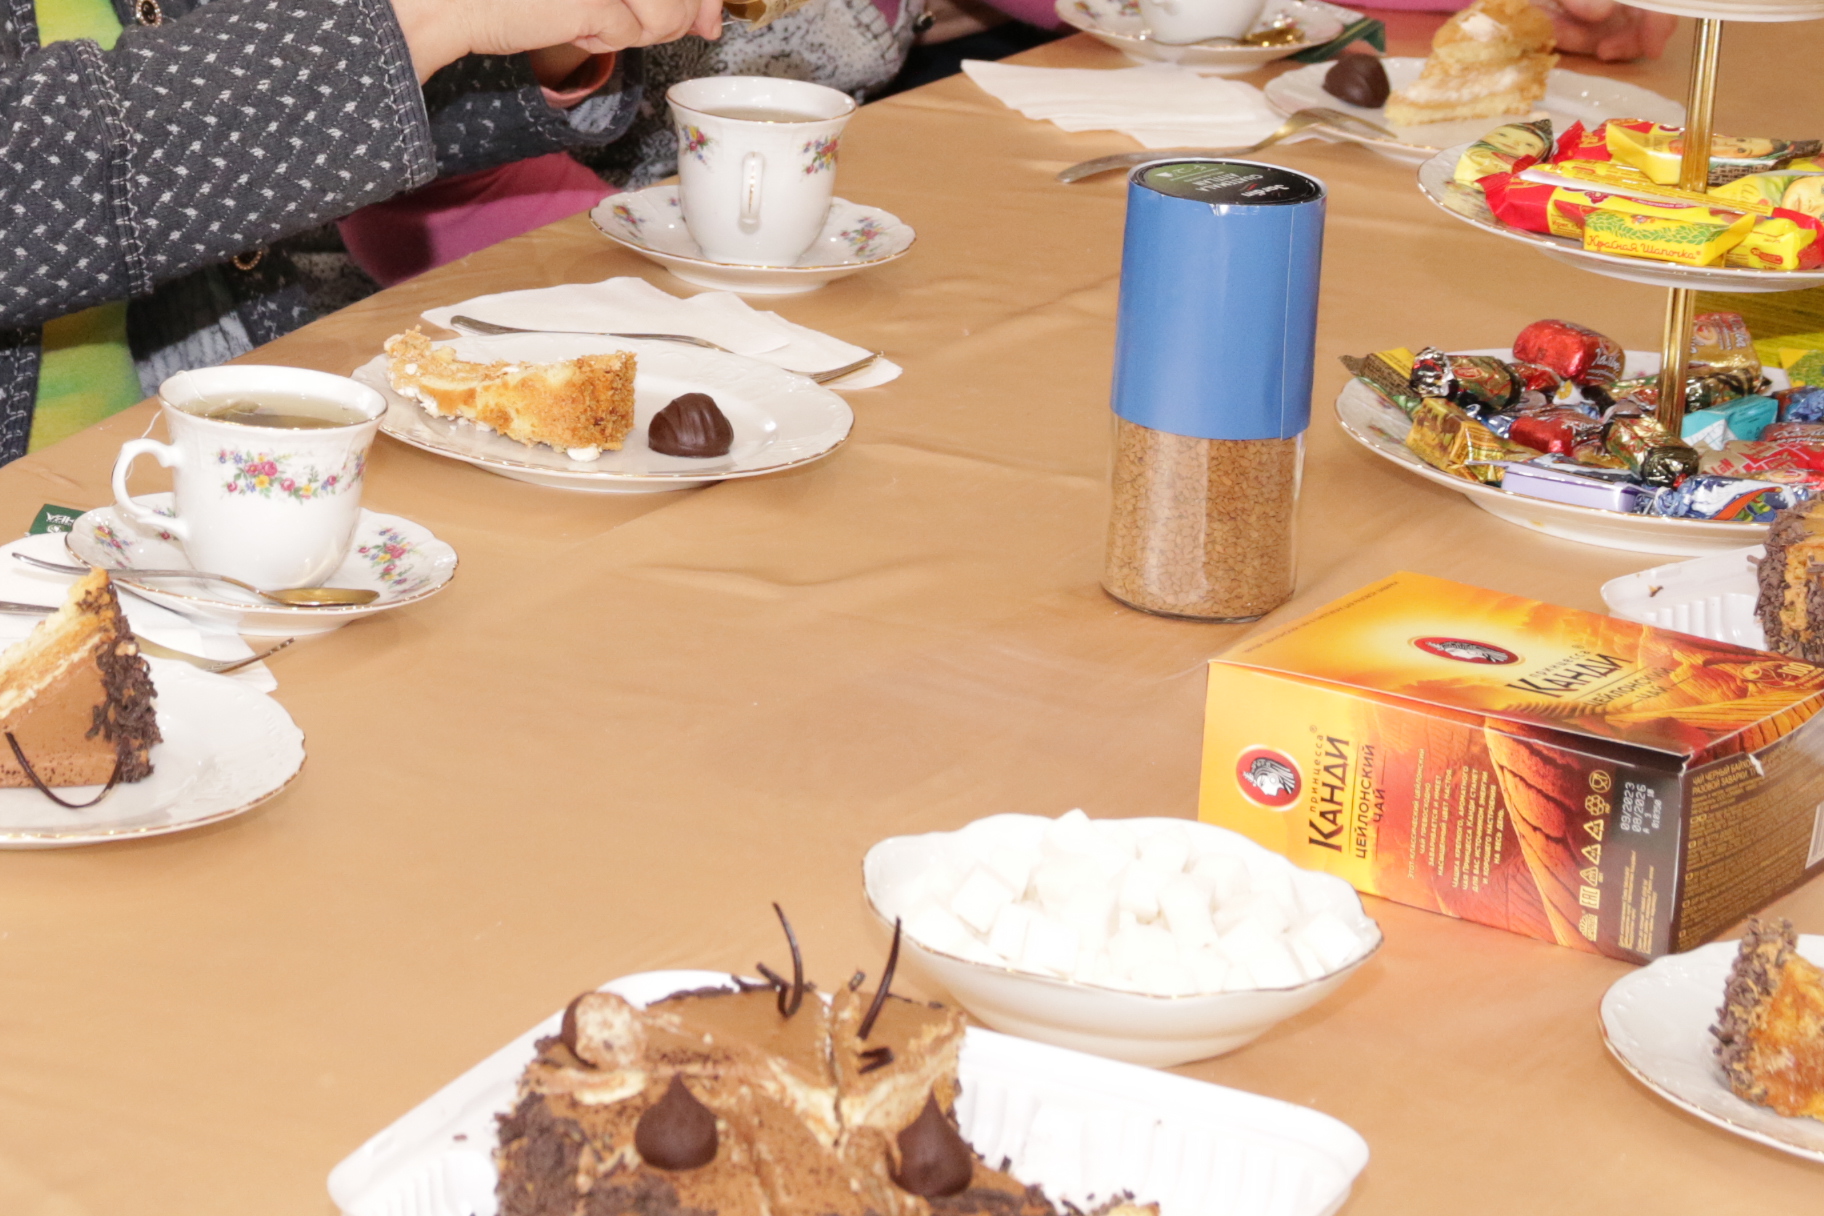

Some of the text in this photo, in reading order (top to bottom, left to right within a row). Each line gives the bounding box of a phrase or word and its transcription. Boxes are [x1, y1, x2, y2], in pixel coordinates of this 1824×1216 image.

[1310, 734, 1323, 813] принцесса
[1354, 744, 1375, 859] ЦЕЙЛОНСКИЙ
[1373, 788, 1385, 822] ЧАЙ
[1620, 782, 1635, 830] 09/2023
[1632, 785, 1646, 832] 08/2026
